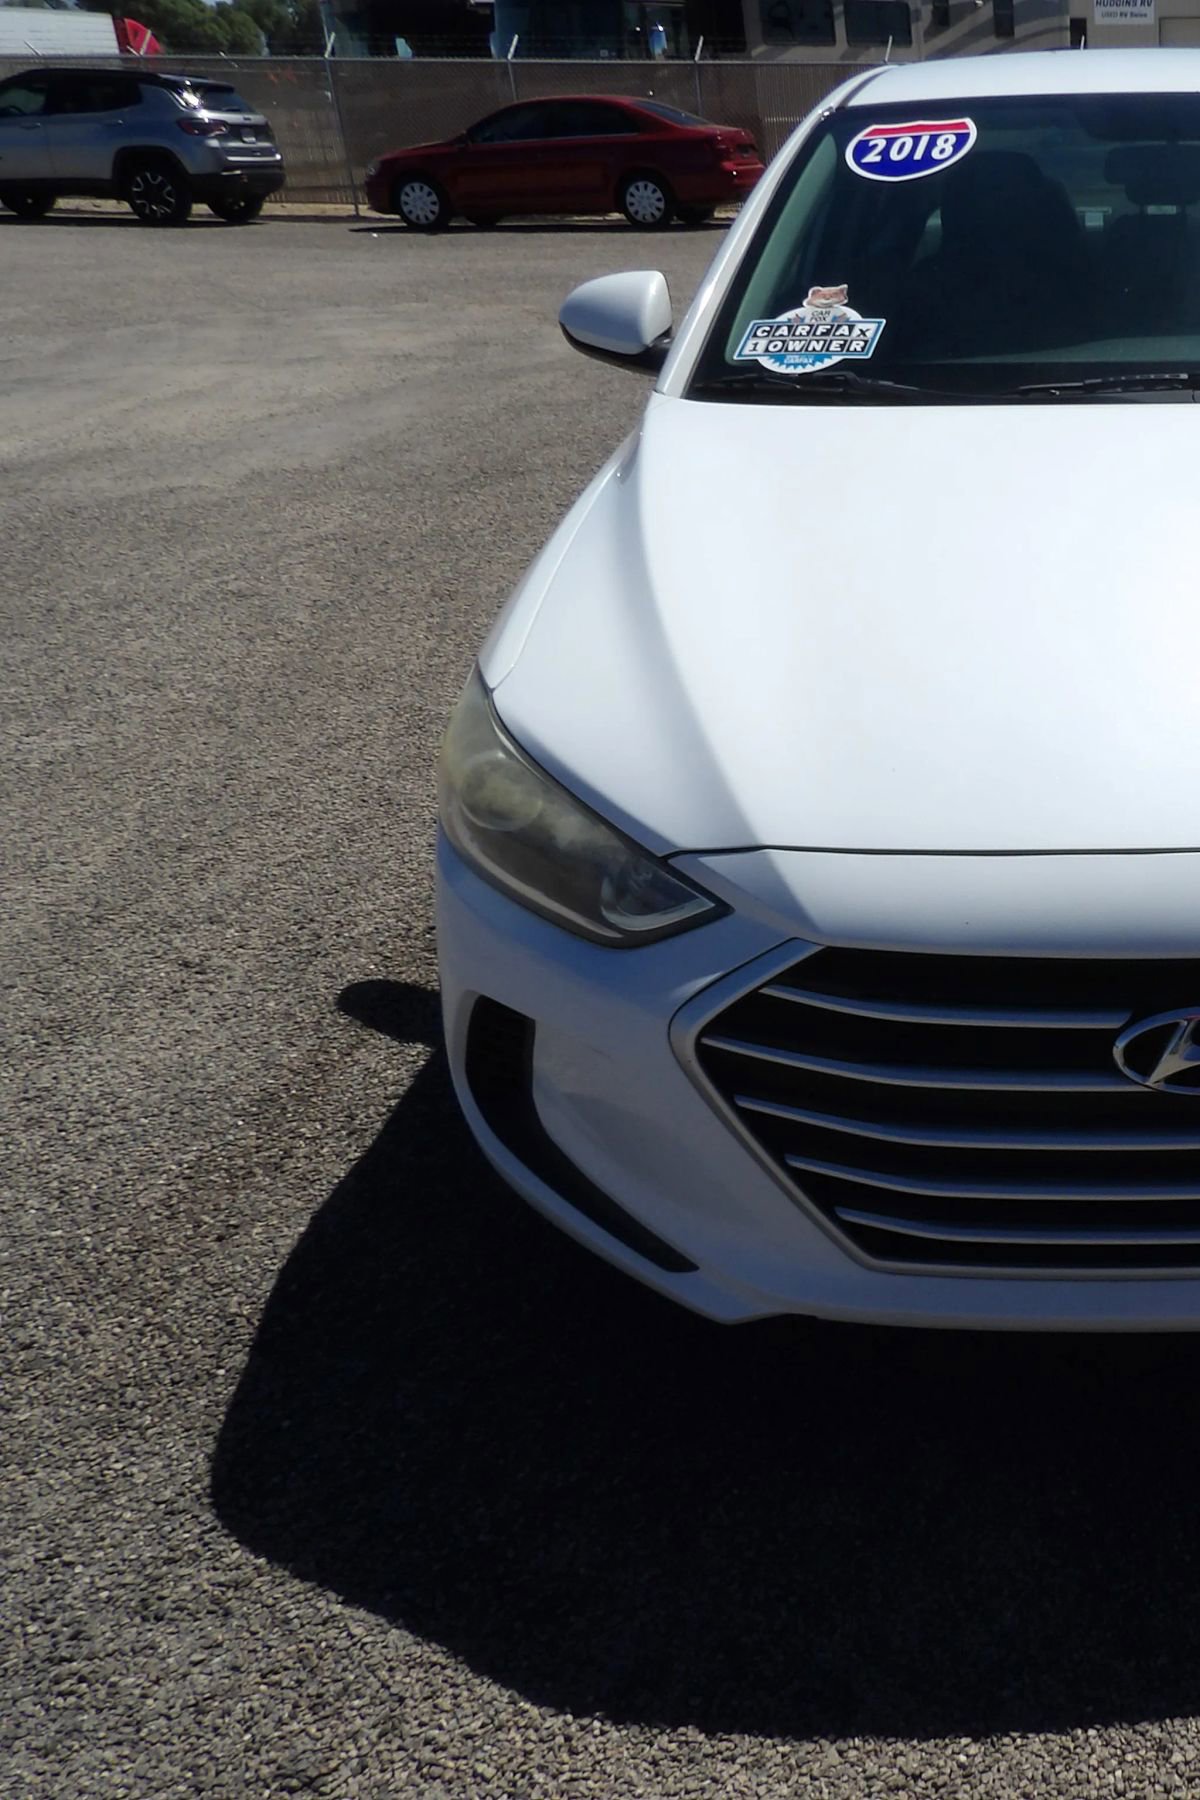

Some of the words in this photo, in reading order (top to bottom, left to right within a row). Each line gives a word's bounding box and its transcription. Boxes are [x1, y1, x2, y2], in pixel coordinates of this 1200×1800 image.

[861, 133, 957, 163] 2018
[754, 324, 874, 338] CARFAX
[748, 341, 761, 352] 1
[767, 339, 866, 353] OWNER
